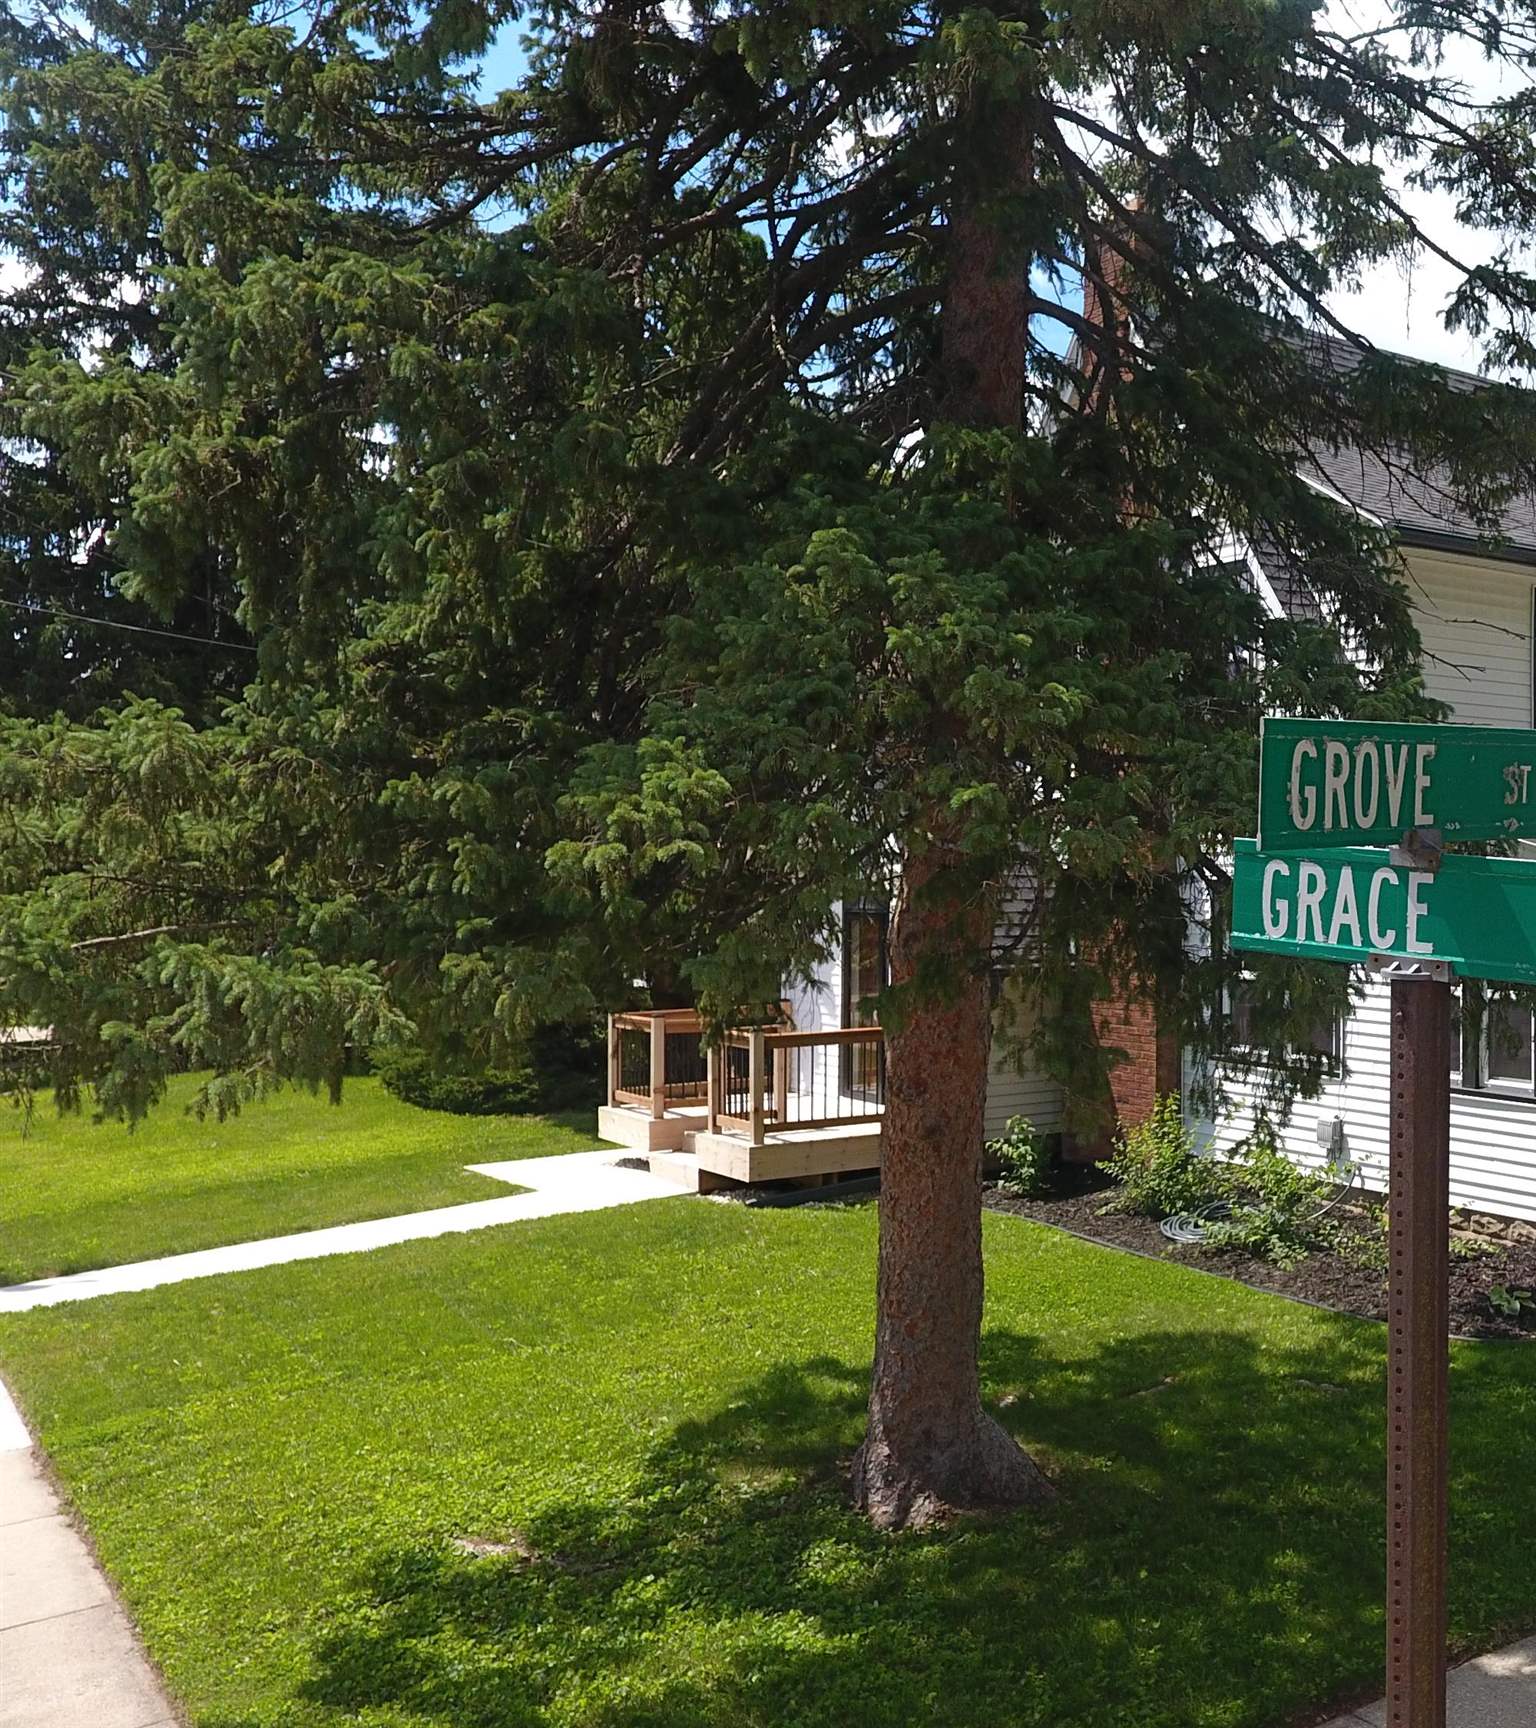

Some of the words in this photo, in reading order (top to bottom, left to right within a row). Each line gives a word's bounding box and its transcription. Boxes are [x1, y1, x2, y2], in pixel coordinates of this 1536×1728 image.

[1289, 739, 1436, 830] GROVE
[1504, 764, 1532, 804] ST
[1262, 860, 1434, 953] GRACE
